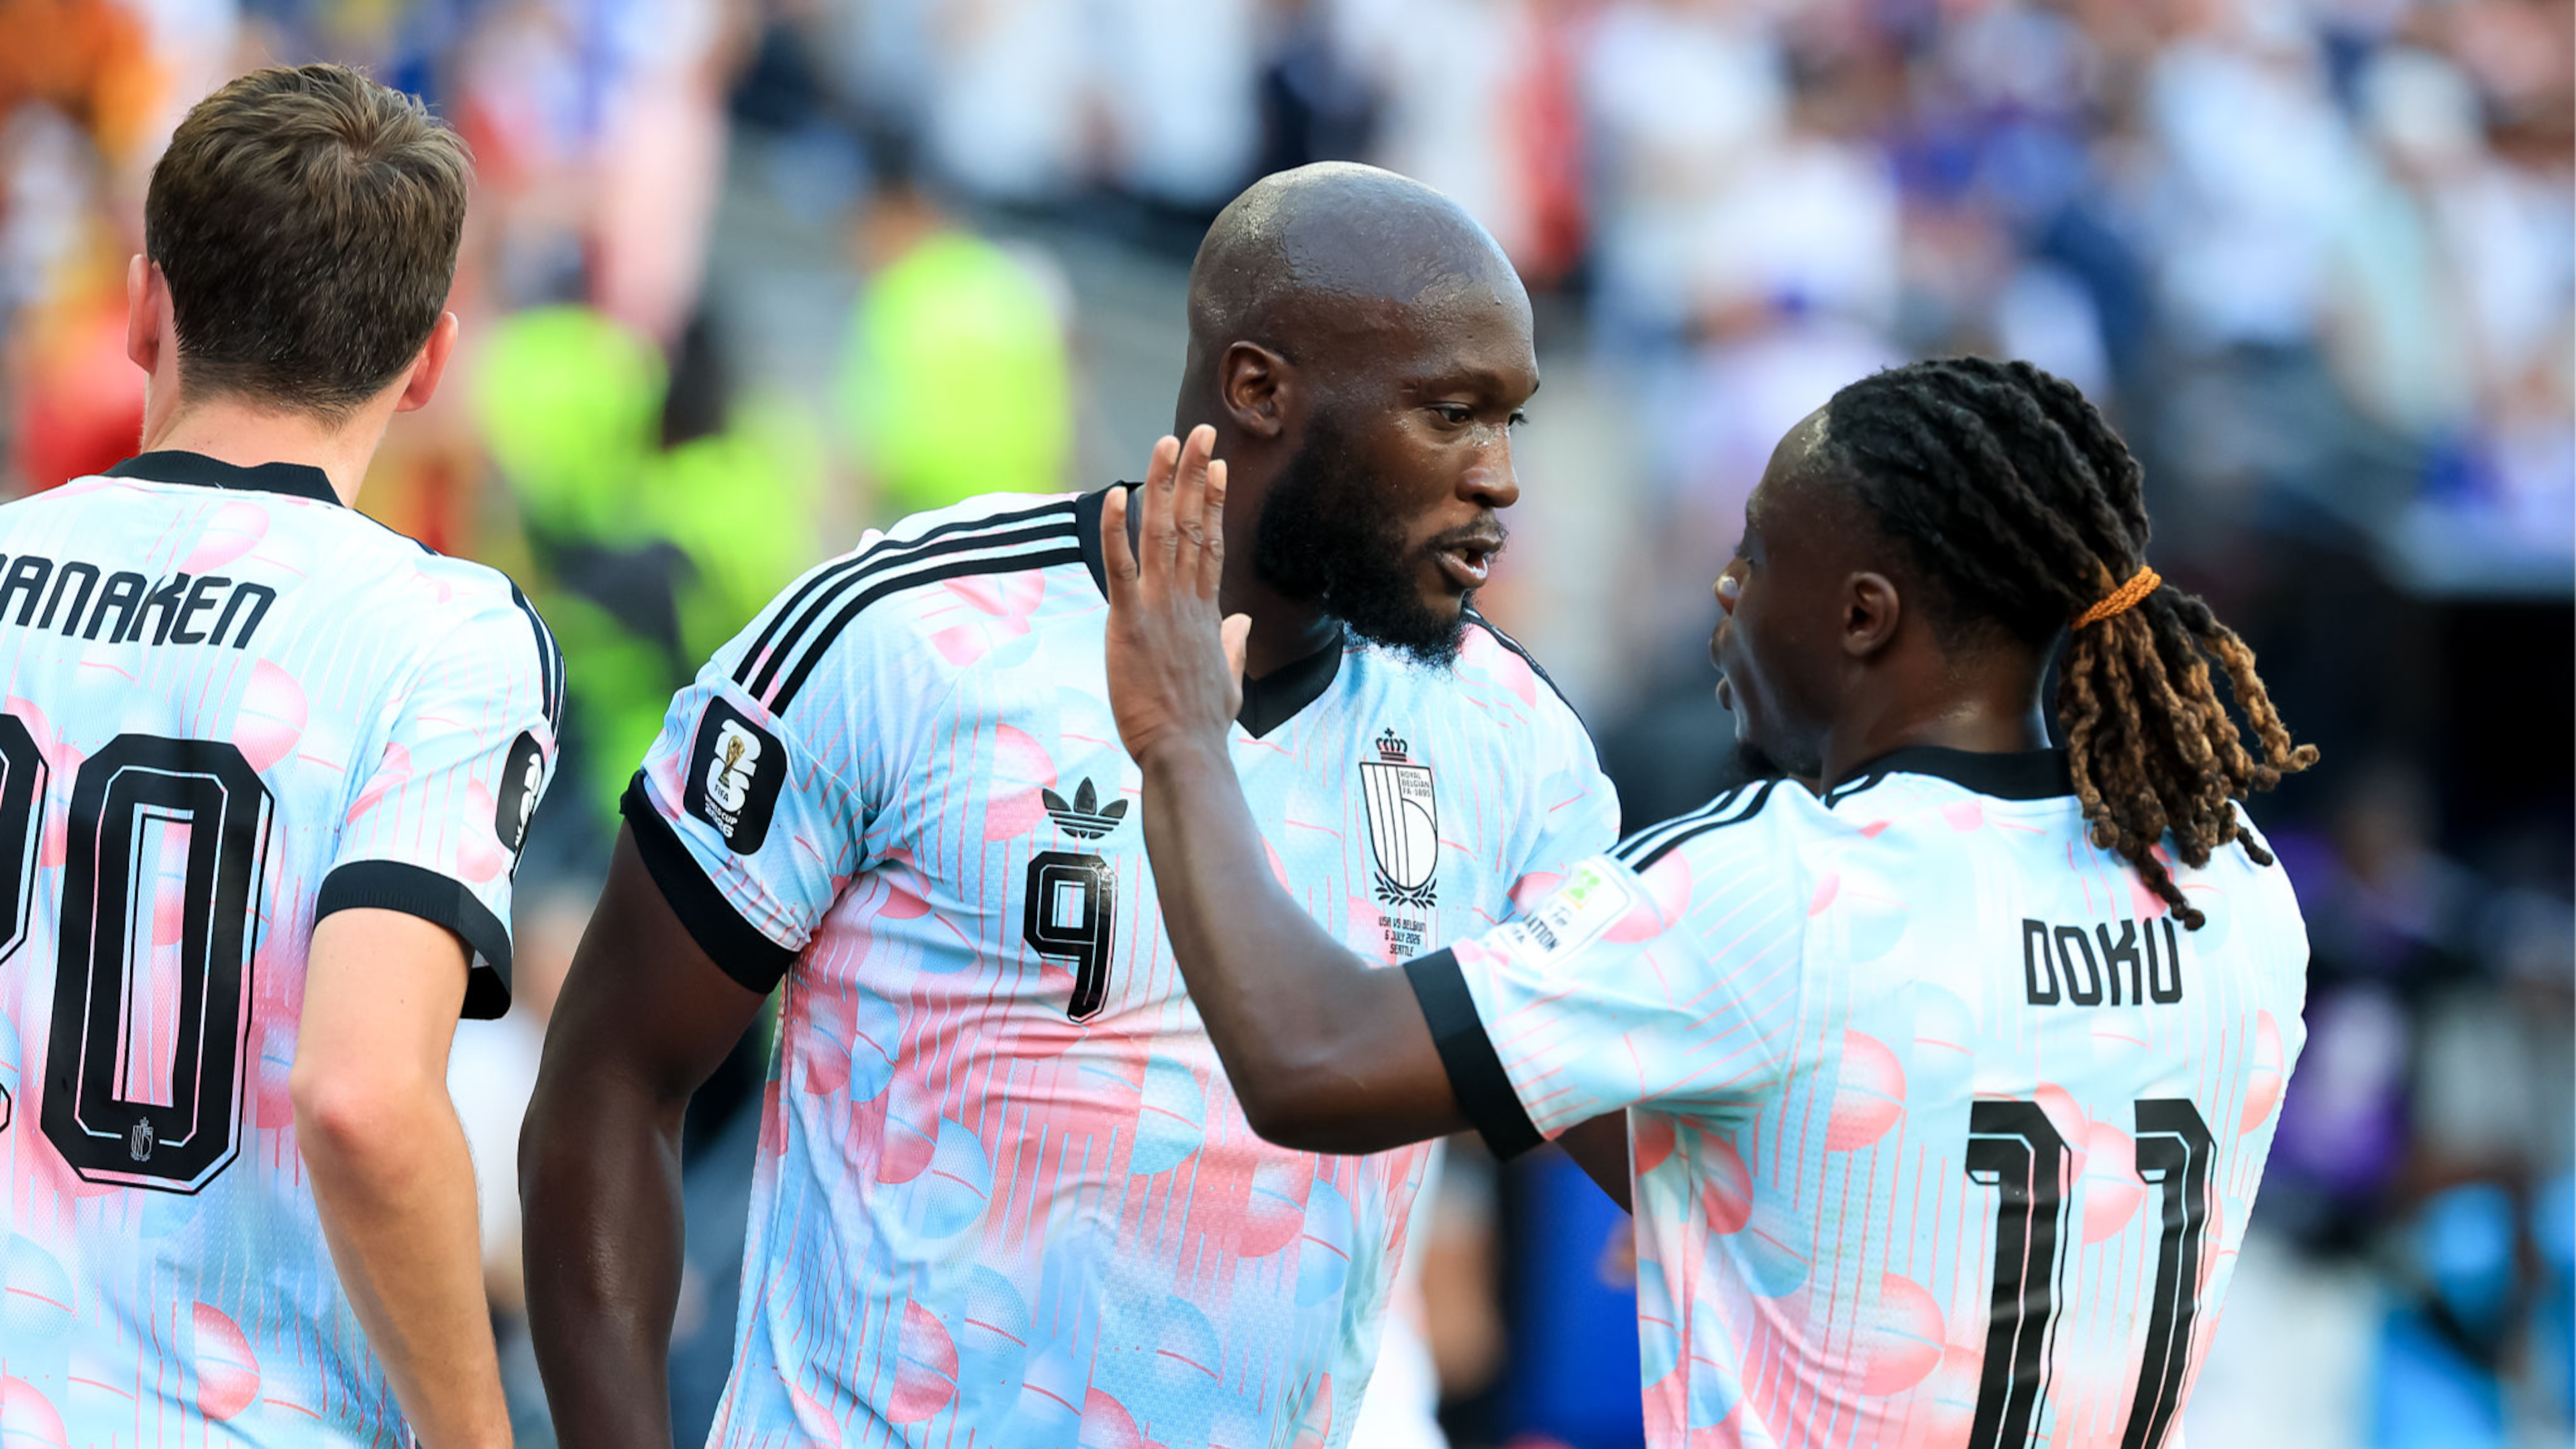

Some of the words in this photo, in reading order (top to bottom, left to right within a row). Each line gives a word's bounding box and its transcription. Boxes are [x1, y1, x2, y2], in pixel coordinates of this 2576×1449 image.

[0, 553, 276, 649] ANAKEN
[1400, 771, 1421, 779] ROYAL
[1402, 778, 1430, 788] BELGIAN
[714, 784, 729, 802] FIFA
[721, 812, 738, 824] CUP
[1379, 916, 1391, 927] USA
[1393, 918, 1401, 929] VS
[1024, 851, 1118, 1023] 9
[1385, 930, 1389, 941] 6
[1391, 930, 1405, 942] JULY
[1406, 932, 1421, 945] 2026
[0, 713, 274, 1195] 0
[1390, 943, 1413, 957] SEATTLE
[2022, 917, 2182, 1006] DOKU
[1966, 1099, 2216, 1449] 11
